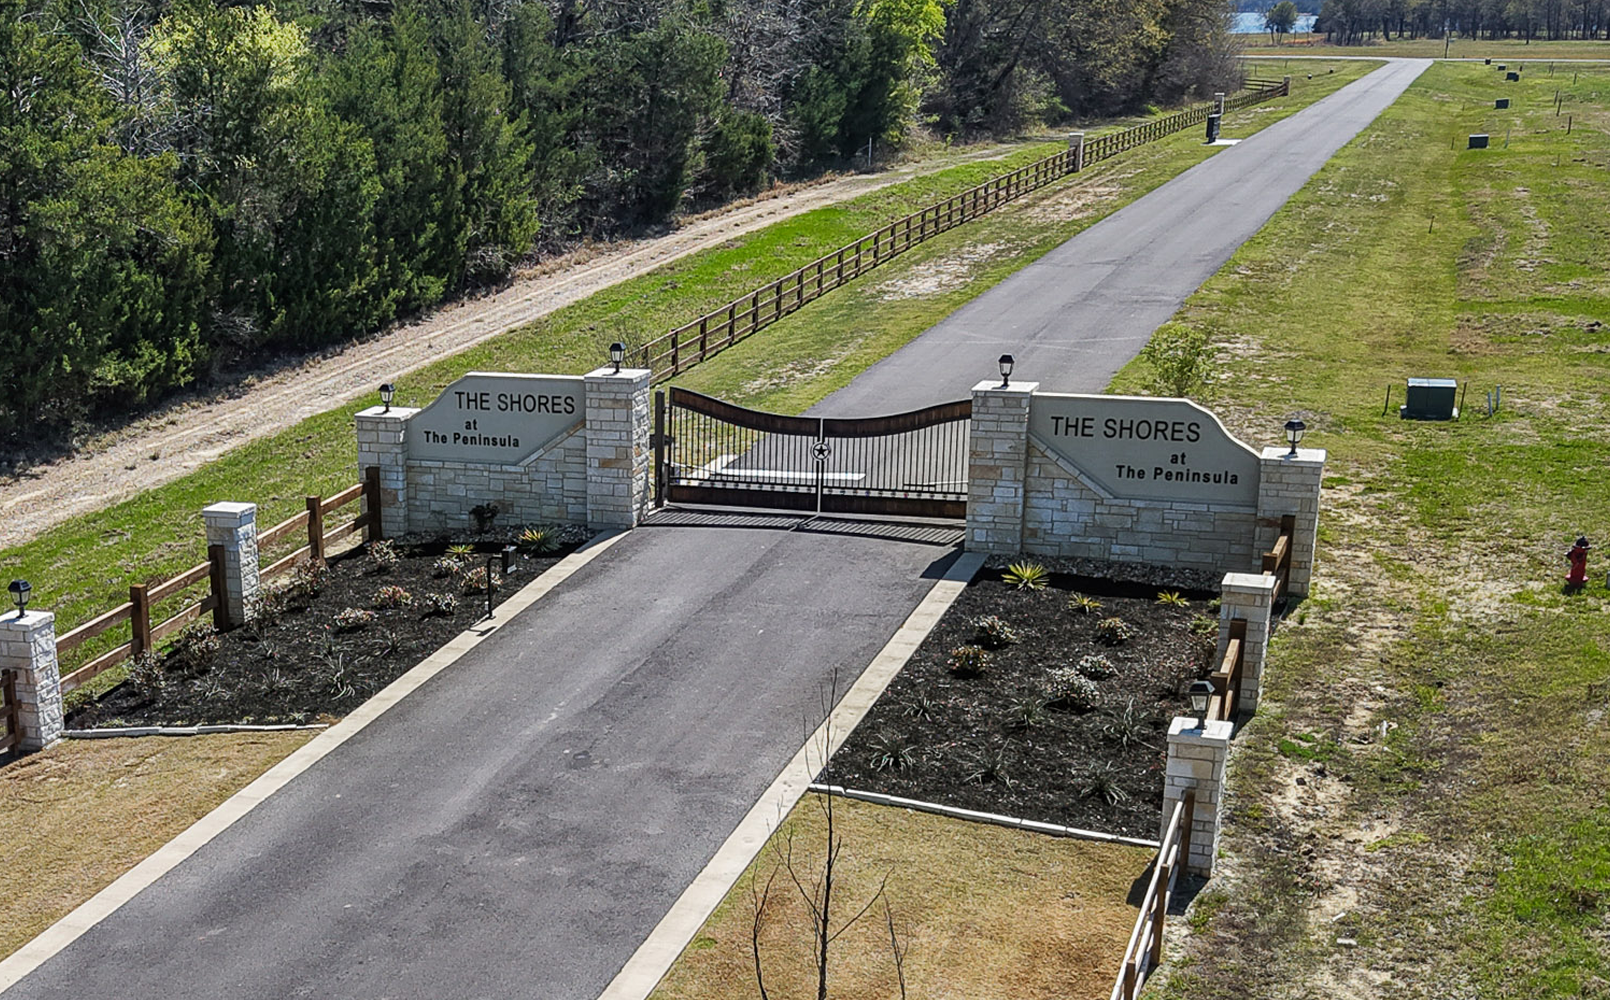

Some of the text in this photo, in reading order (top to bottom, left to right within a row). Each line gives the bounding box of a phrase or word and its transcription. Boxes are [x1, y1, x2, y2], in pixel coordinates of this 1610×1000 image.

[454, 391, 575, 415] THE SHORES
[465, 419, 478, 431] at
[1051, 416, 1201, 443] THE SHORES
[424, 431, 520, 448] The Peninsula
[1170, 452, 1186, 465] at
[1116, 465, 1239, 485] The Peninsula
